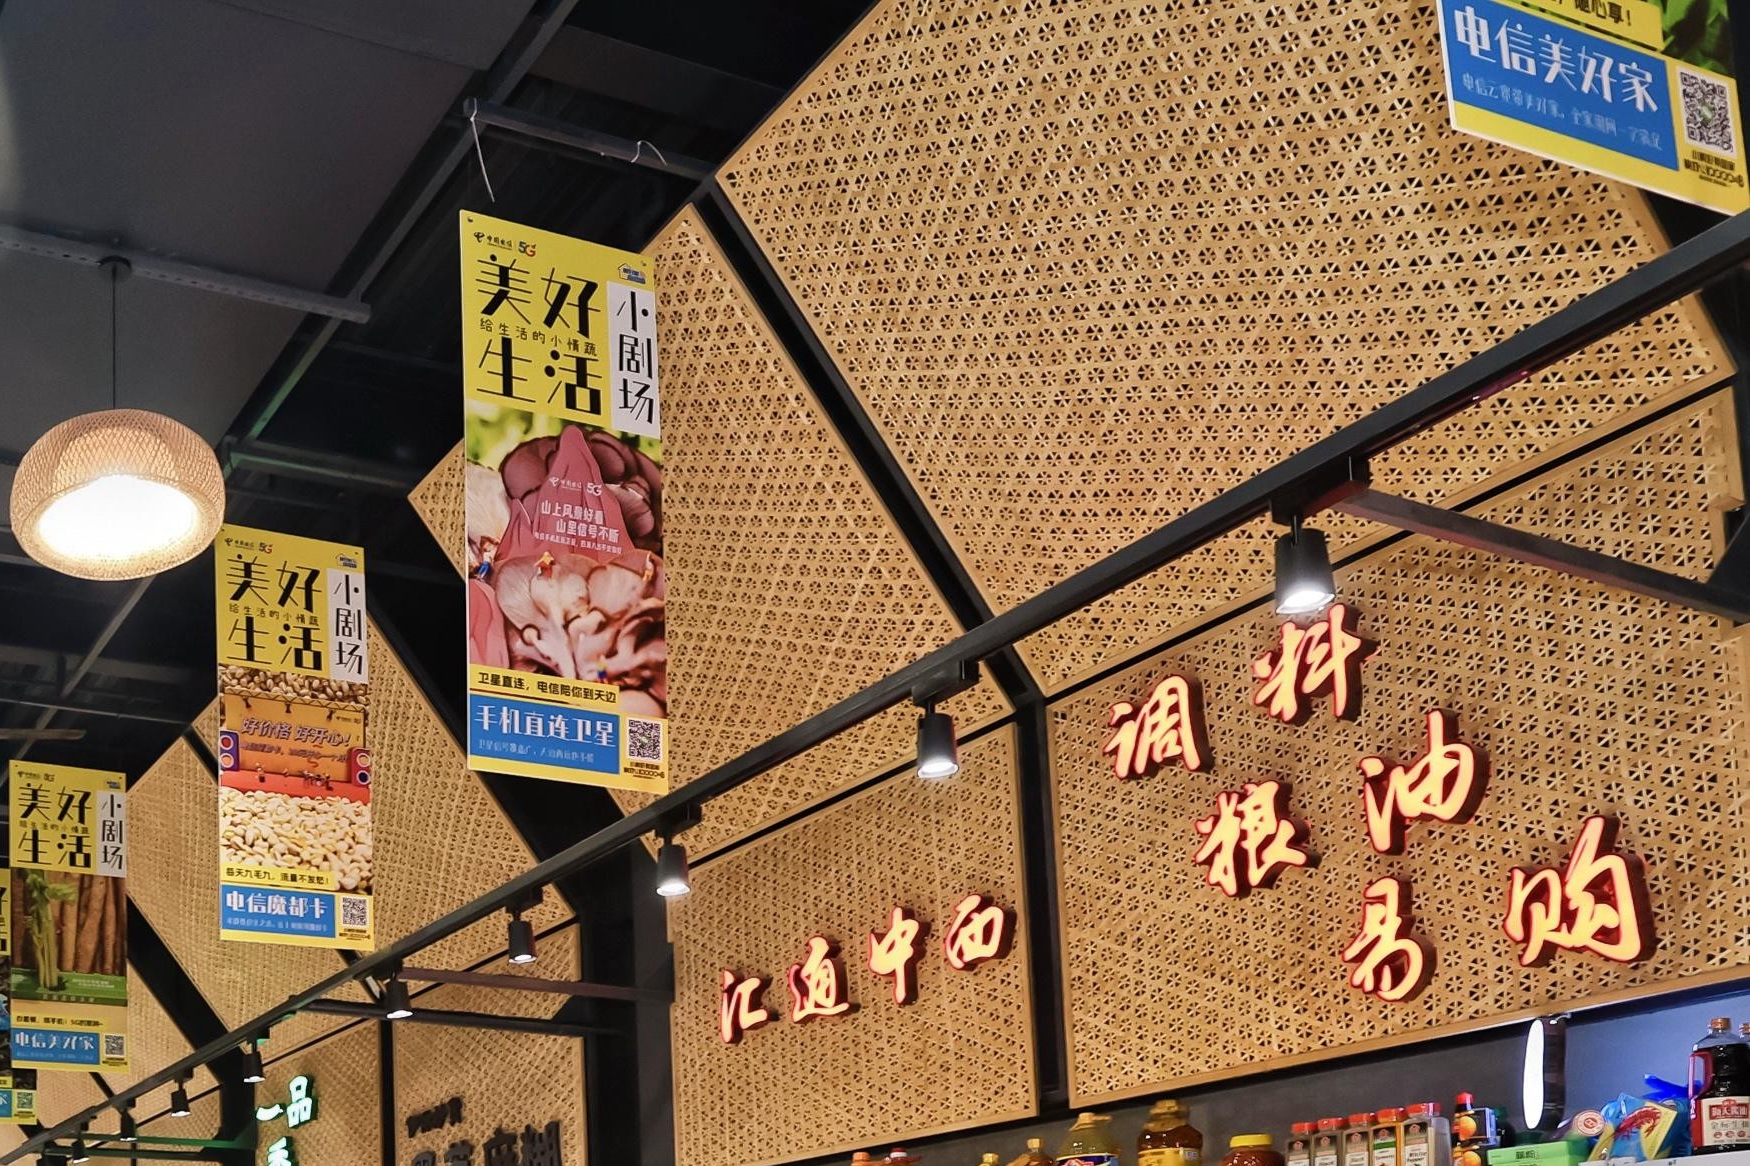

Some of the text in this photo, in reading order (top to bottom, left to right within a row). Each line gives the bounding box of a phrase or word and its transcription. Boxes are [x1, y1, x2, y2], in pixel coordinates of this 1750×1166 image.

[1454, 5, 1659, 113] 电信美好家
[518, 241, 536, 257] 5G
[476, 254, 601, 339] 美好
[480, 318, 598, 357] 给生活的小情蔬
[617, 291, 655, 424] 小剧场
[476, 336, 602, 416] 生活
[587, 483, 602, 496] 5G
[541, 500, 604, 525] 山上风景好看
[556, 519, 619, 543] 山里信号不断
[226, 554, 322, 613] 美好
[229, 603, 319, 627] 给生活的小情蔬
[334, 574, 363, 675] 小剧场
[226, 615, 323, 671] 生活
[478, 672, 617, 704] 卫星直连，电信陪你到天边
[241, 717, 292, 740] 好价格
[474, 705, 617, 748] 手机直连卫星
[18, 783, 92, 825] 美好
[17, 829, 92, 868] 生活
[101, 794, 122, 870] 小剧场
[226, 890, 328, 919] 电信魔都卡
[719, 892, 1006, 1045] 汇通中西
[256, 1075, 312, 1128] 一品
